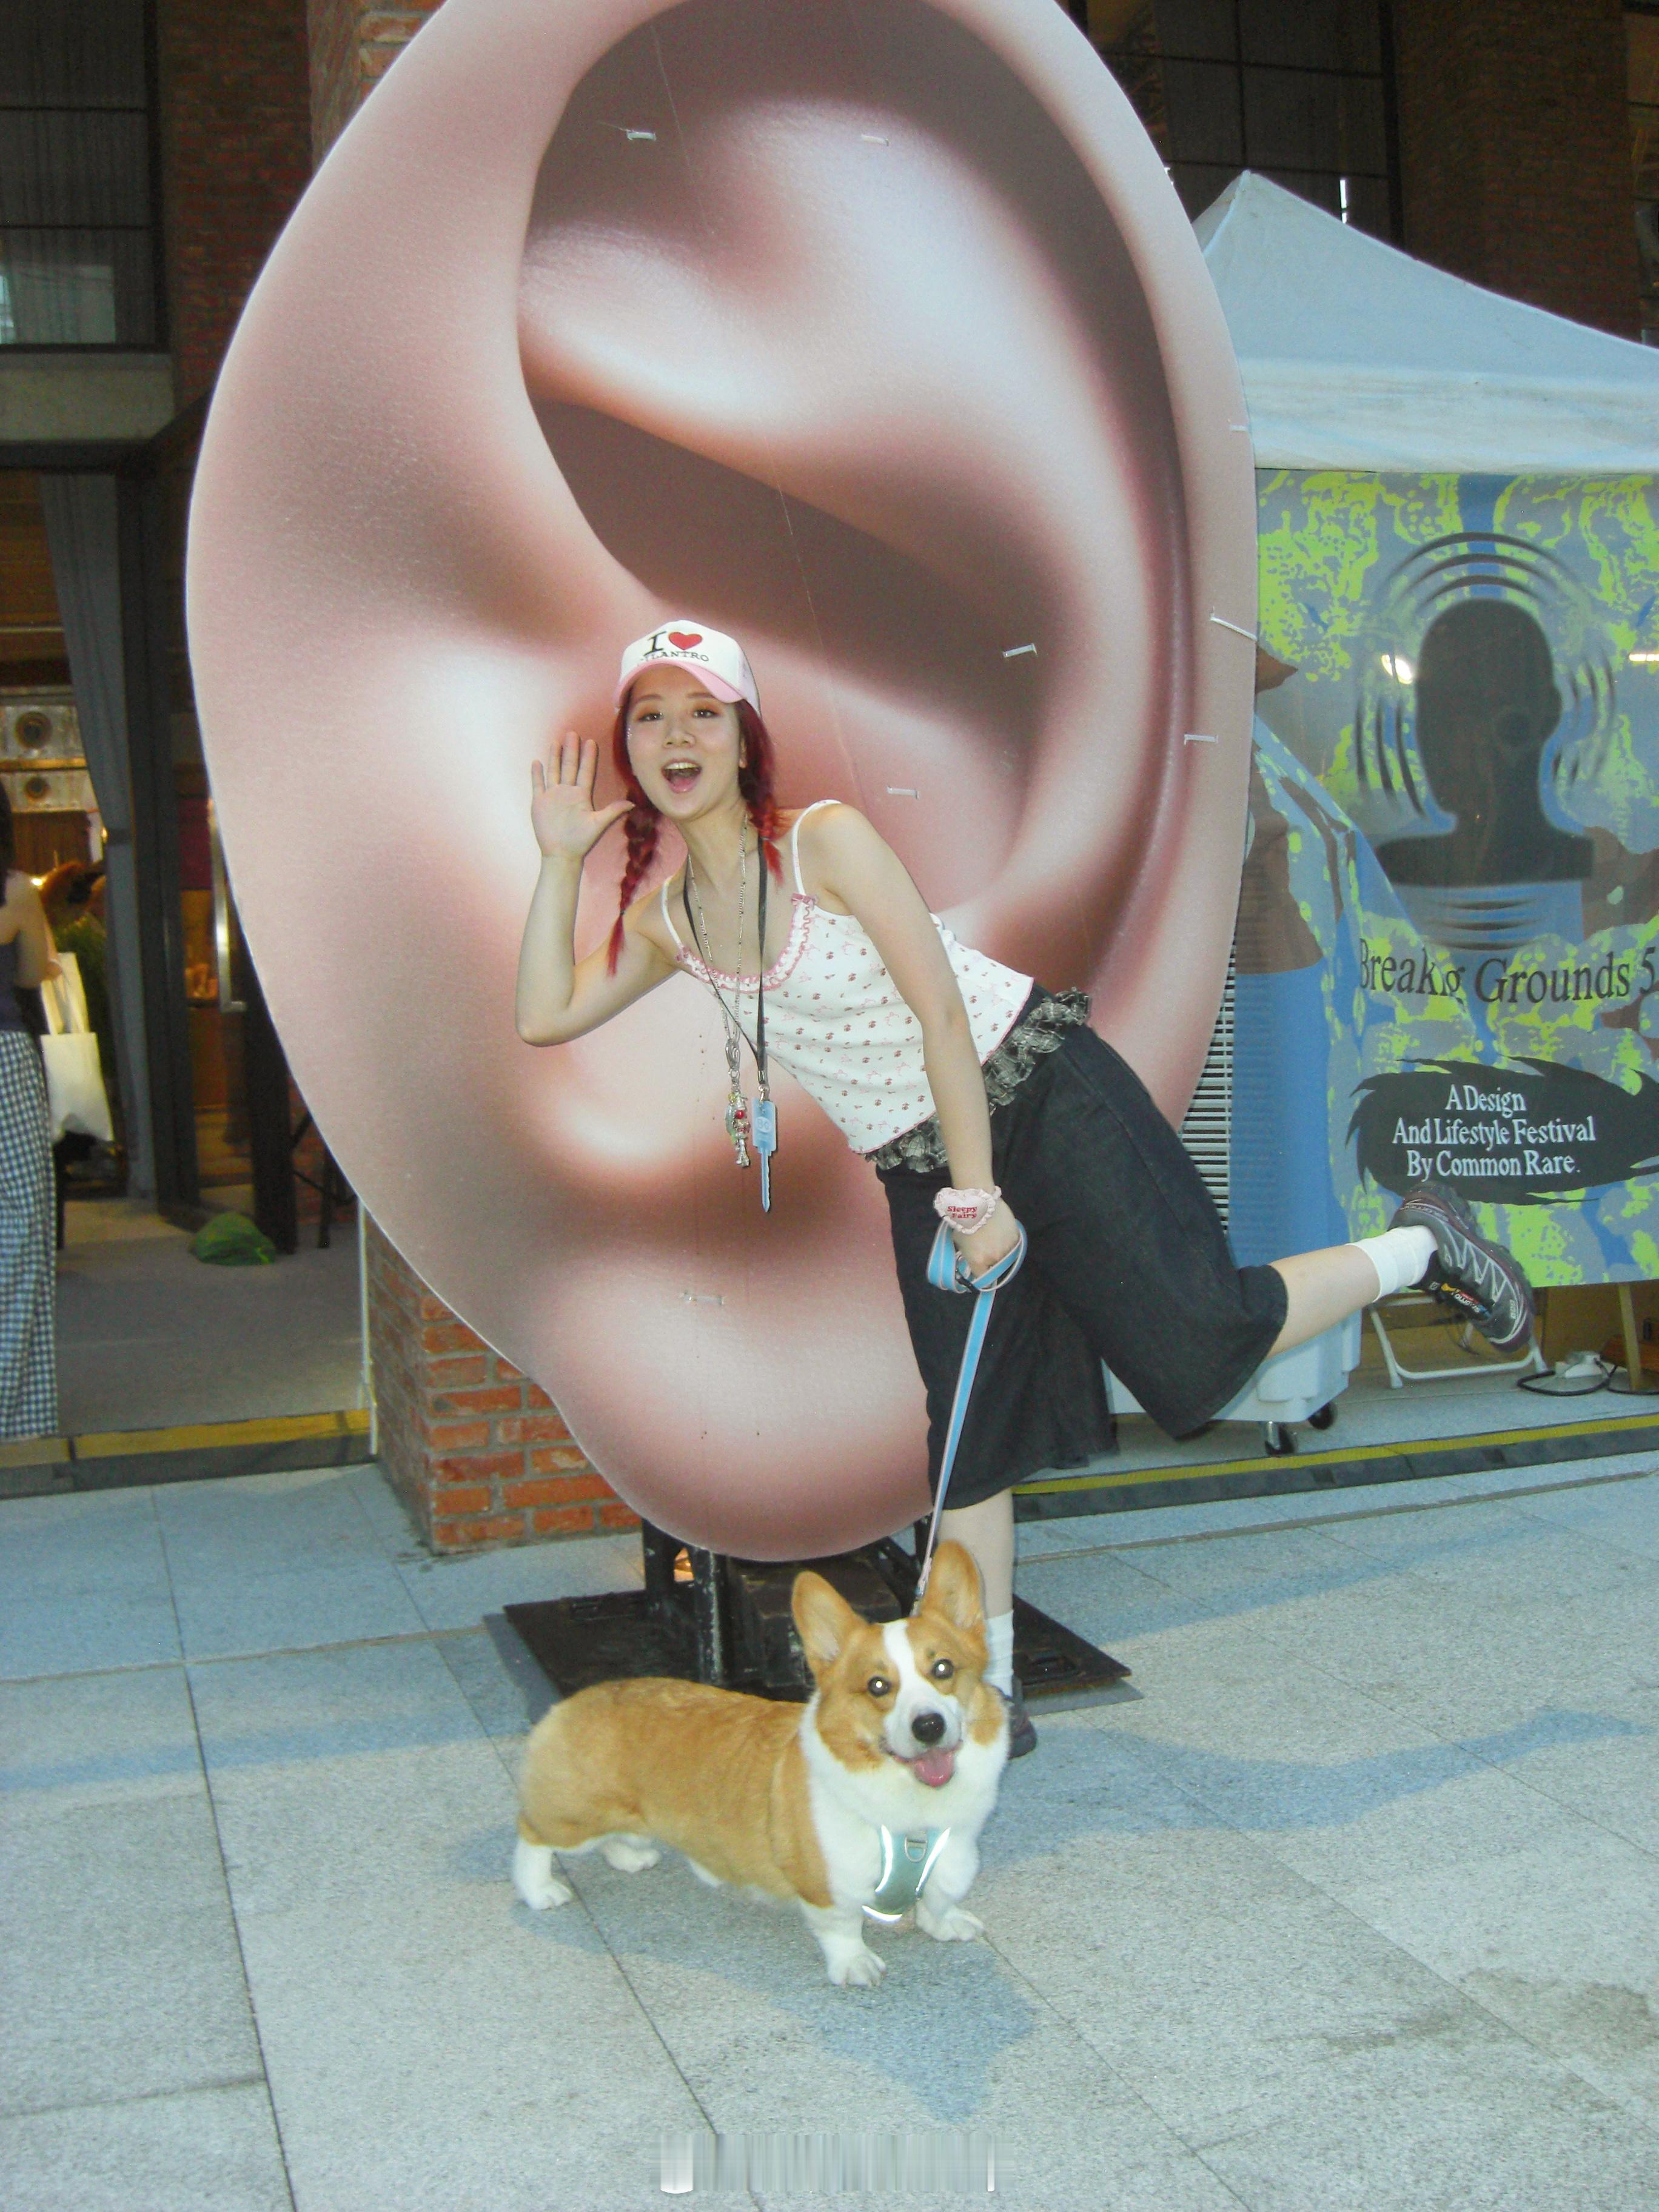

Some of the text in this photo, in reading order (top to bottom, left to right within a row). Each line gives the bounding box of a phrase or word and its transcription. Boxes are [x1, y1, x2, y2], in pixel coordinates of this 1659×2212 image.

[643, 631, 666, 656] I
[1474, 951, 1630, 1003] Grounds
[1639, 946, 1656, 994] 5
[1445, 1084, 1527, 1119] A Design
[1392, 1115, 1596, 1151] And Lifestyle Festival
[1406, 1150, 1581, 1182] By Common Rare.
